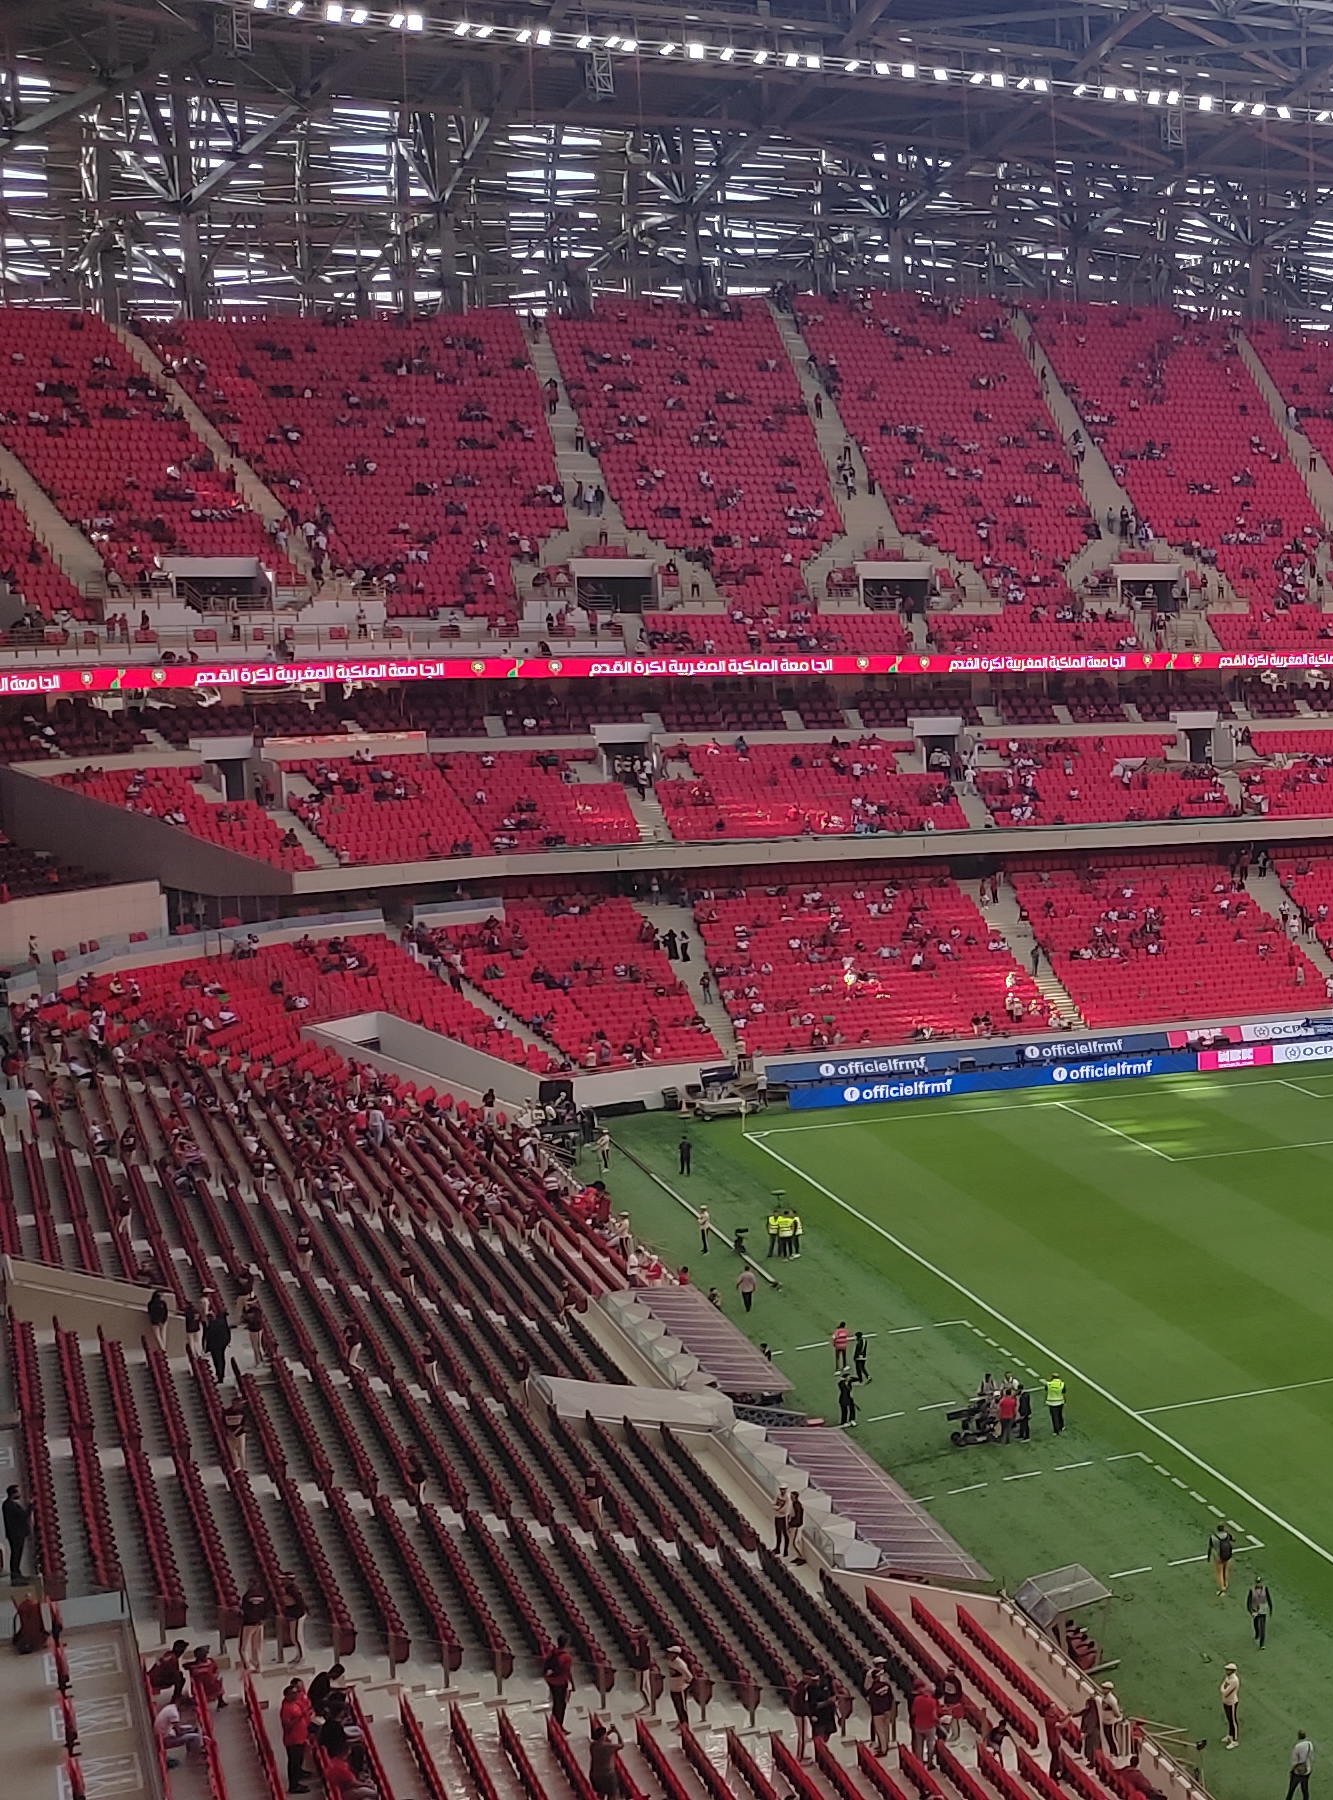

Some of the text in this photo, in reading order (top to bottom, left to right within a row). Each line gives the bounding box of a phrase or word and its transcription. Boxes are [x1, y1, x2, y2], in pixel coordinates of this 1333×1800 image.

[590, 660, 631, 676] القدم
[634, 660, 666, 675] لكرة
[195, 669, 238, 686] القدم
[241, 668, 273, 684] لكرة
[1272, 1025, 1300, 1035] OCP
[1042, 1039, 1124, 1057] officielfrmf
[1302, 1045, 1333, 1056] OCP
[838, 1057, 926, 1075] officielfrmf
[1070, 1060, 1152, 1079] officielfrmf
[862, 1079, 953, 1099] officielfrmf
